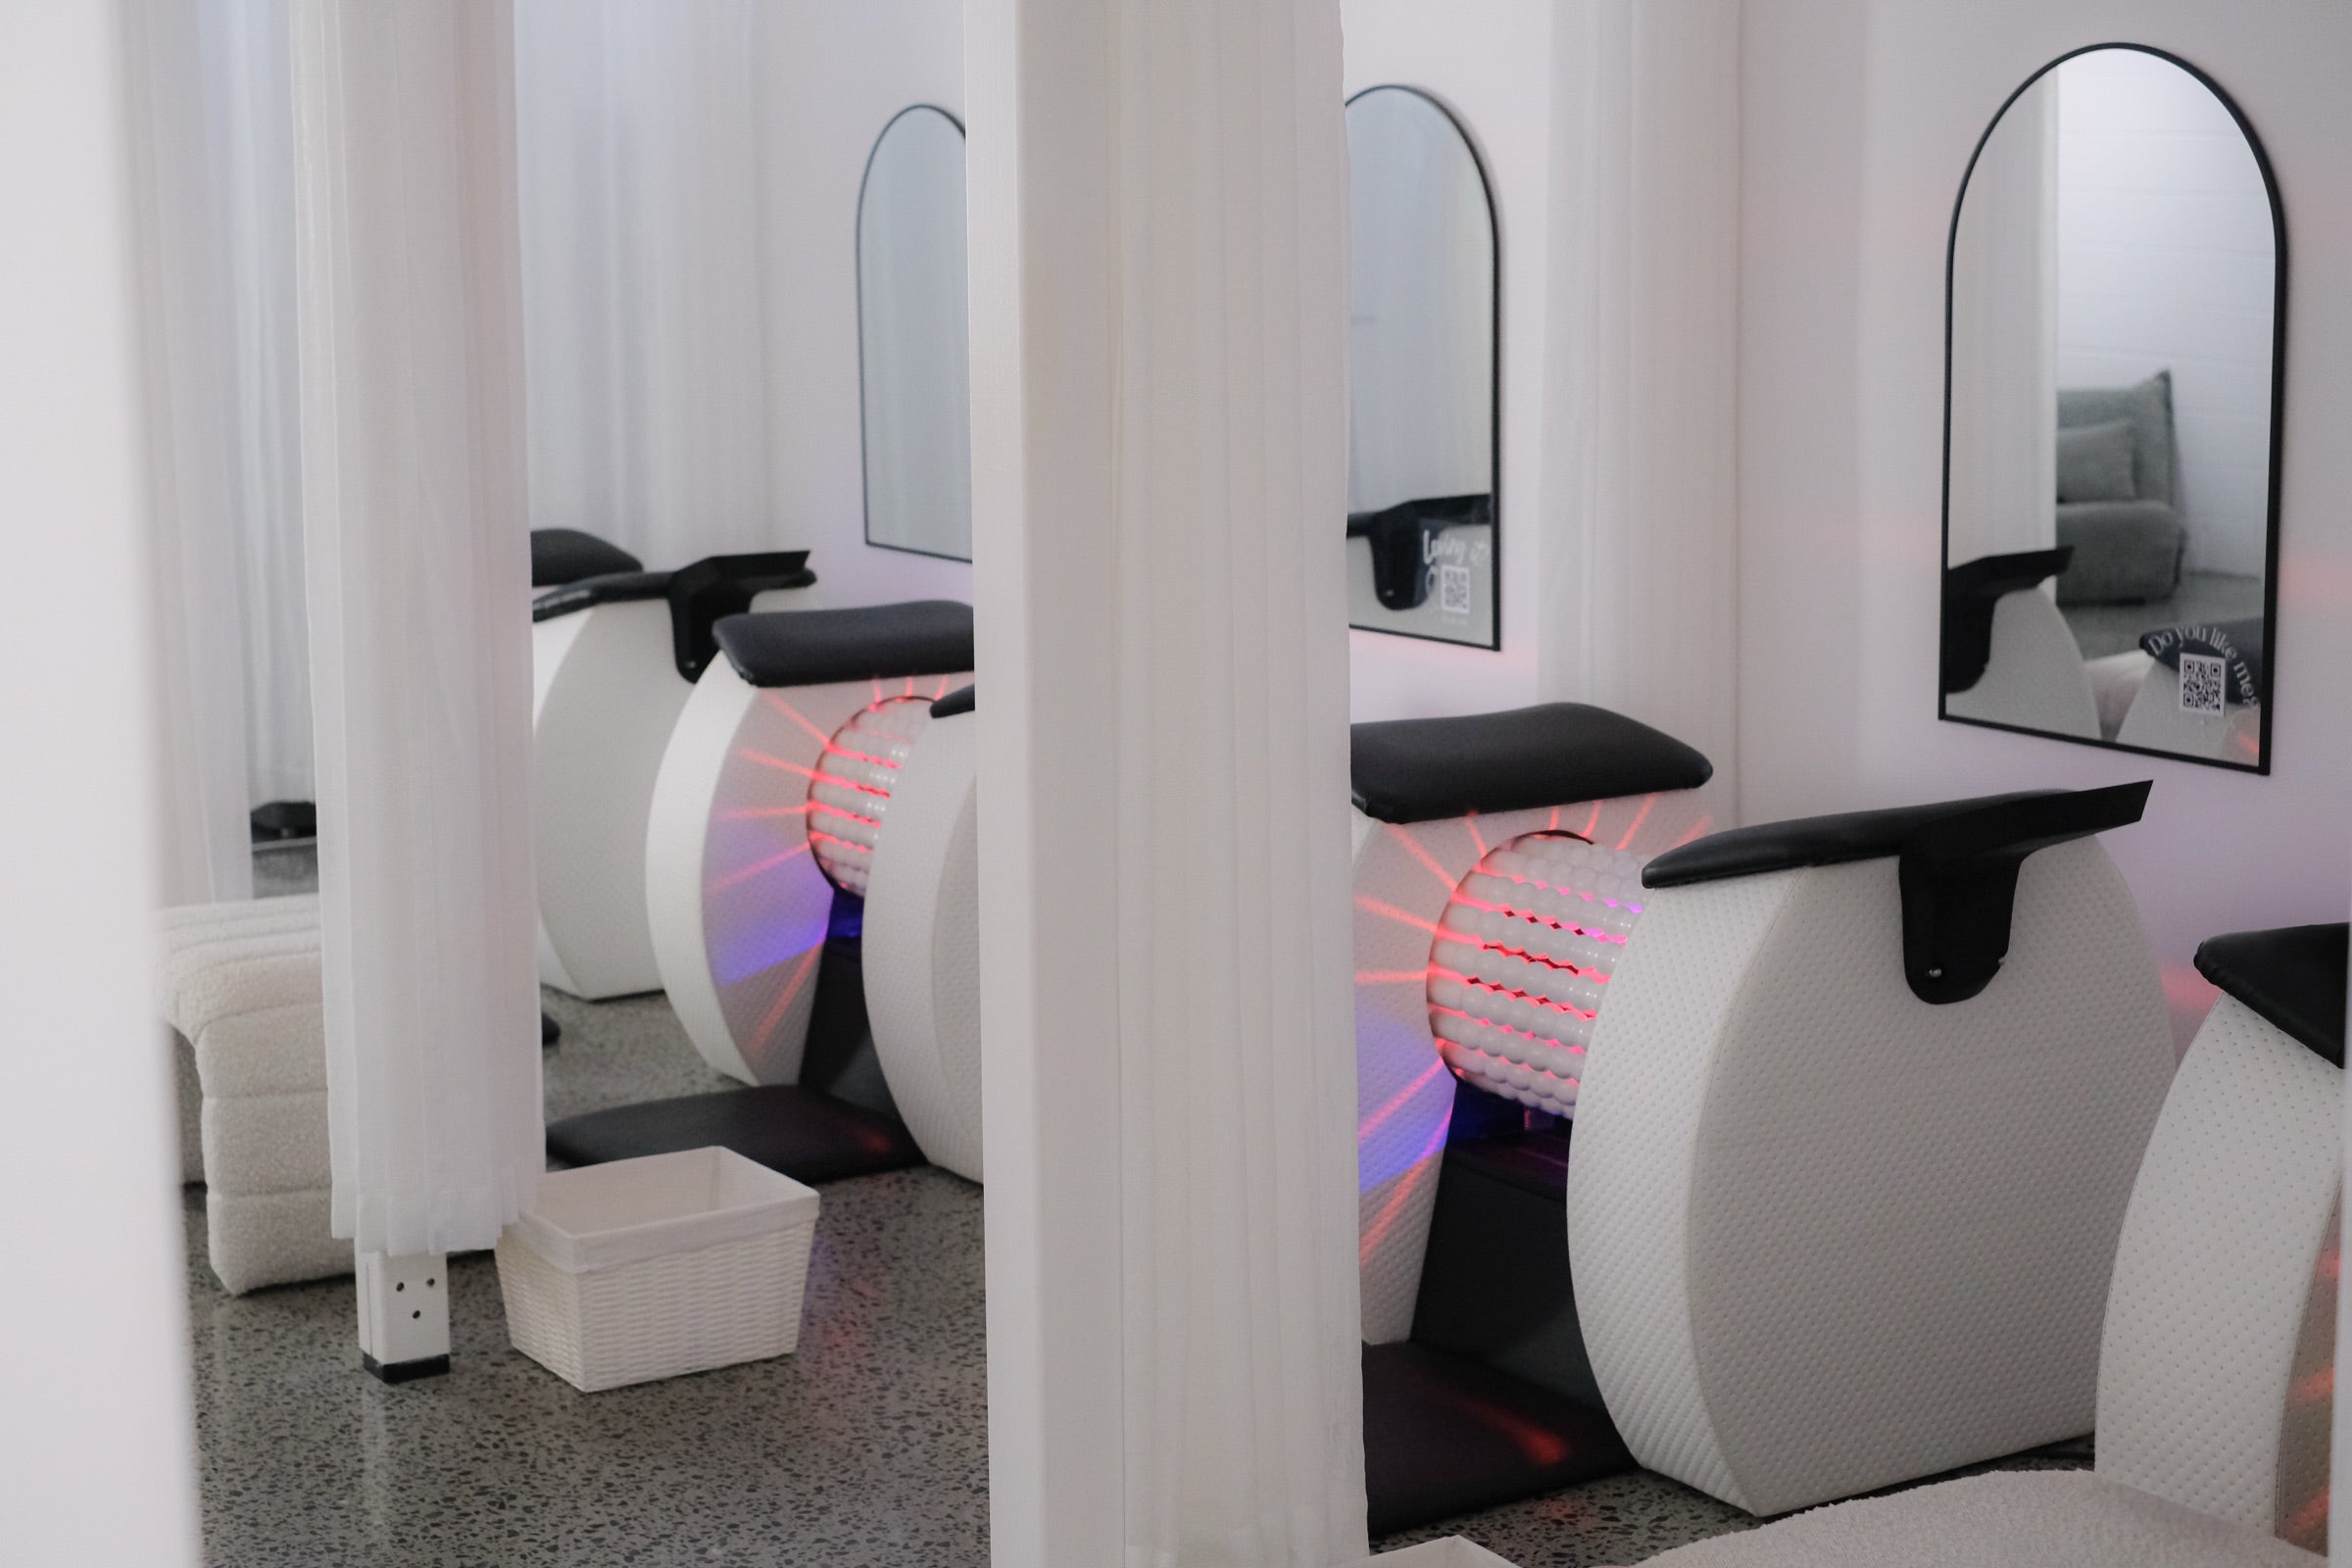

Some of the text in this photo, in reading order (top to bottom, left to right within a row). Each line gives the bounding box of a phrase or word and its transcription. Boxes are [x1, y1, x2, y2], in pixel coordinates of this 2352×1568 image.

[2148, 631, 2174, 656] Do
[2175, 626, 2207, 648] you
[2209, 627, 2236, 659] like
